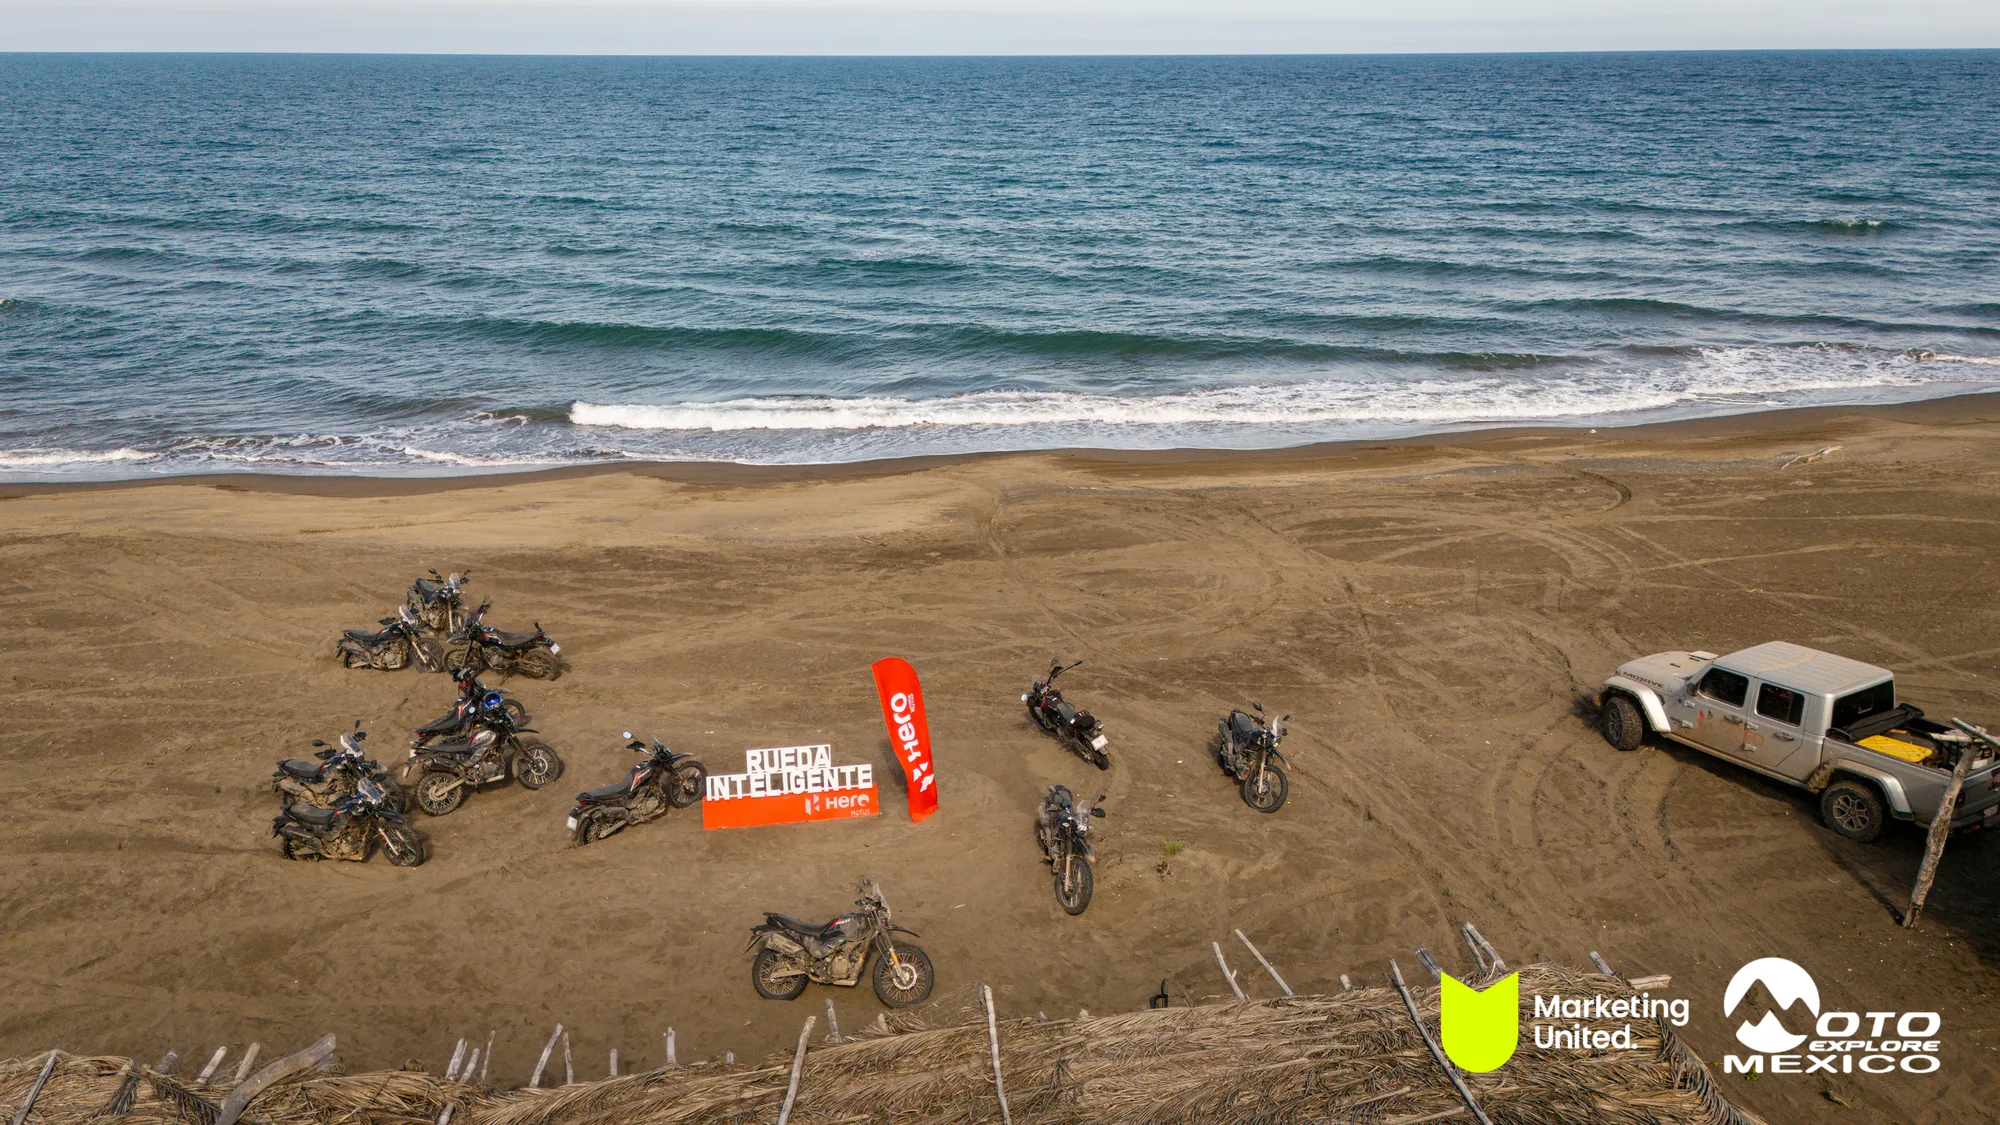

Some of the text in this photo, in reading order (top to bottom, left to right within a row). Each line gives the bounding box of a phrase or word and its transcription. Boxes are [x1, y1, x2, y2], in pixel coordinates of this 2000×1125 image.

[1623, 671, 1664, 688] MOJAVE
[890, 692, 922, 762] Hero
[747, 745, 831, 773] RUEDA
[706, 765, 873, 802] INTELIGENTE
[825, 794, 870, 810] Hero
